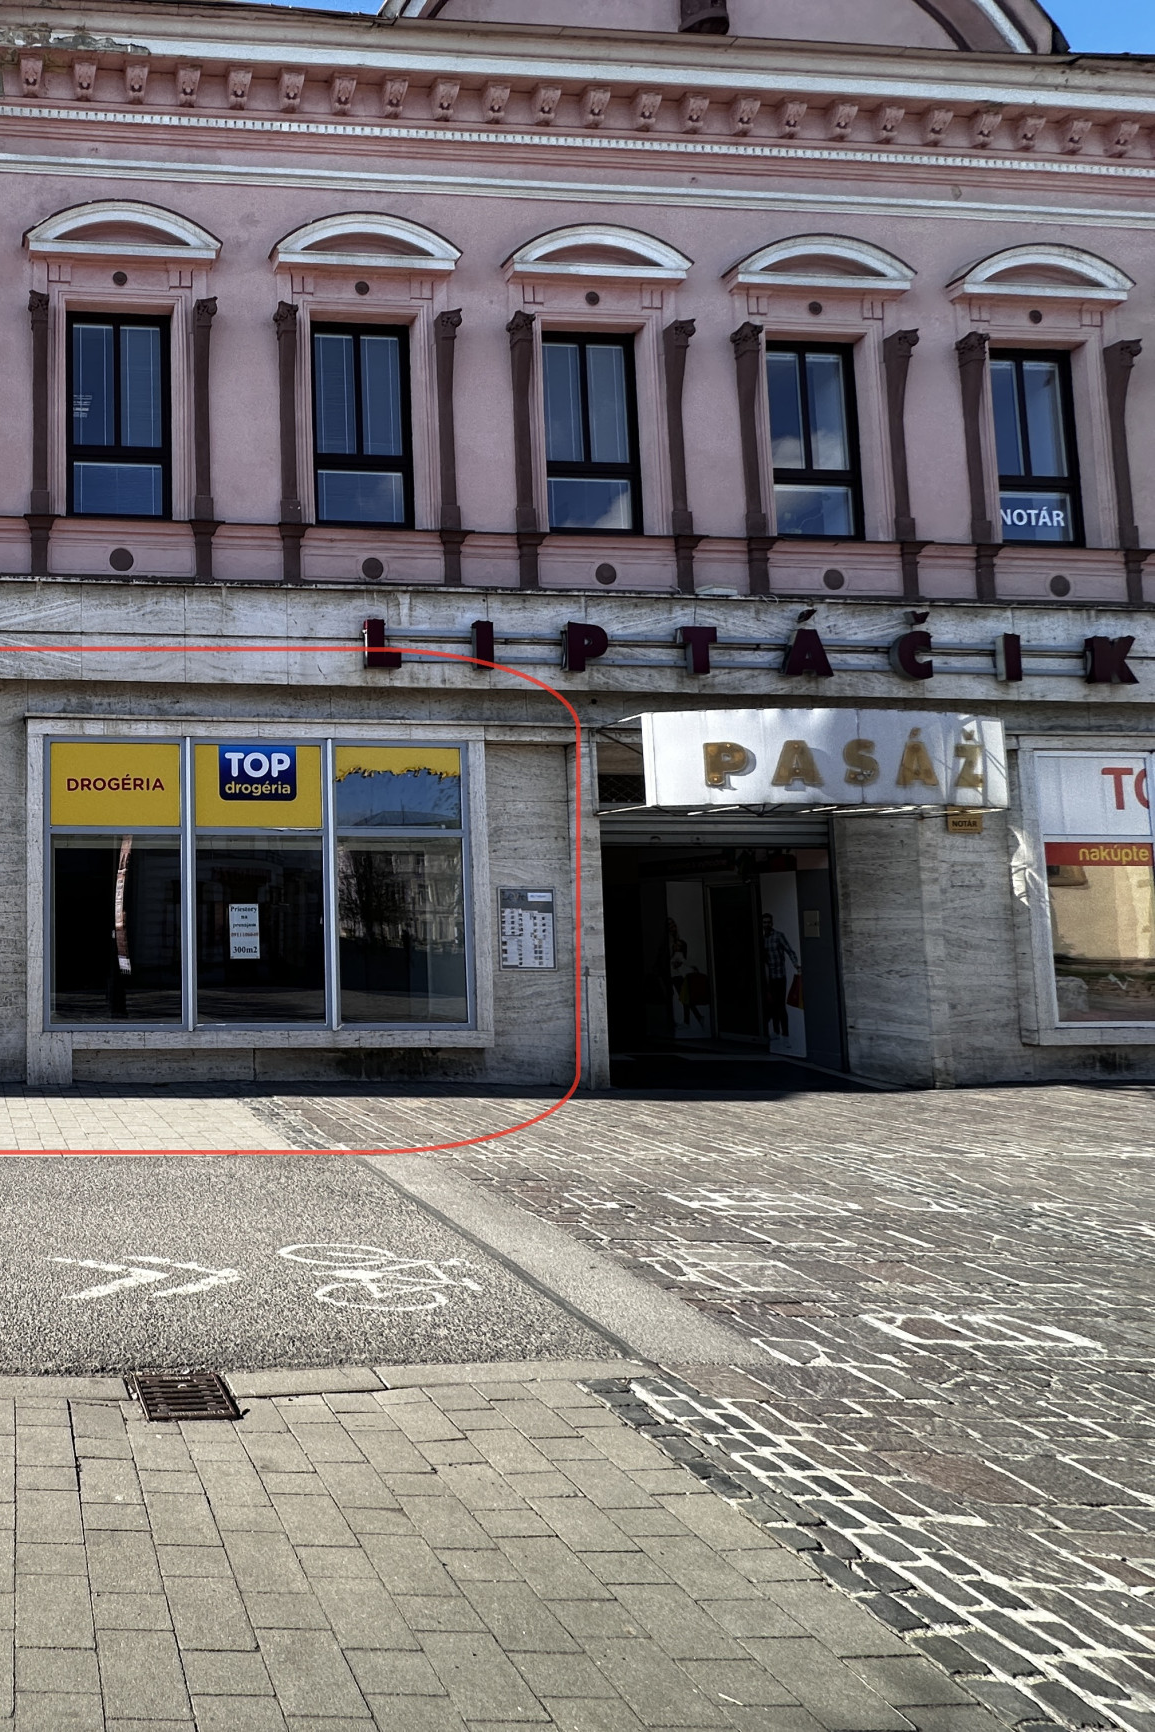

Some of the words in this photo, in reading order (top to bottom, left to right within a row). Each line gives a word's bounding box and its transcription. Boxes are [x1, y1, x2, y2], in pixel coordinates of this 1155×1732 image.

[1000, 507, 1065, 527] NOTÁR
[225, 752, 291, 778] TOP
[703, 727, 985, 788] PASÁŽ
[67, 774, 165, 791] DROGÉRIA
[225, 781, 291, 796] drogéria
[1079, 845, 1149, 864] nakúpte
